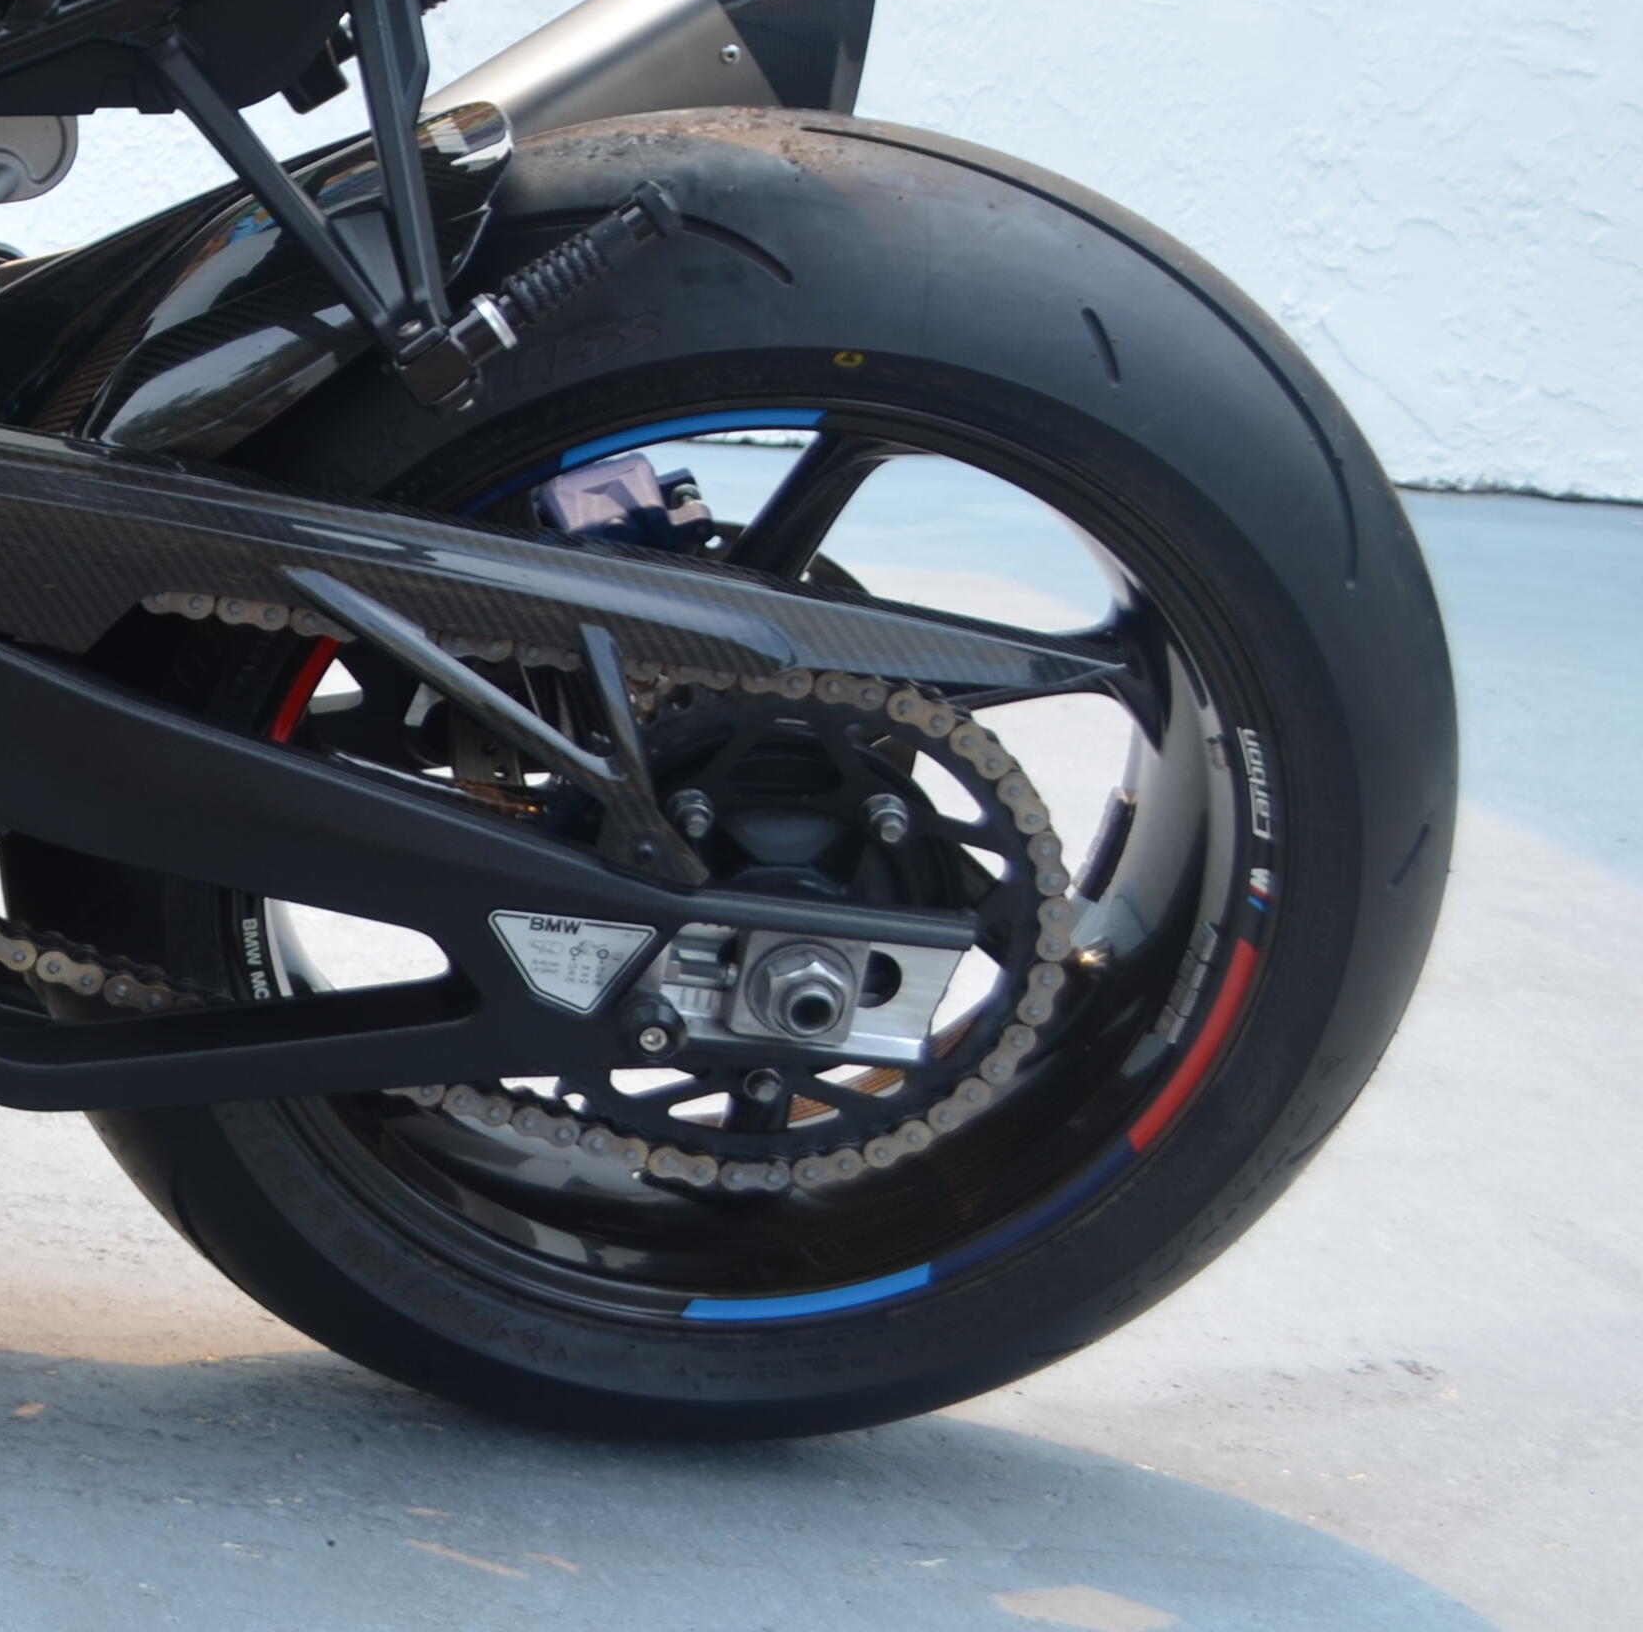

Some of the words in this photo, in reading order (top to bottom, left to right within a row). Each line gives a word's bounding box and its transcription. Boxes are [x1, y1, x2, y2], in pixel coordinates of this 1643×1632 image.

[1236, 726, 1271, 840] Carbon
[242, 918, 262, 966] BMW
[528, 916, 583, 936] BMW
